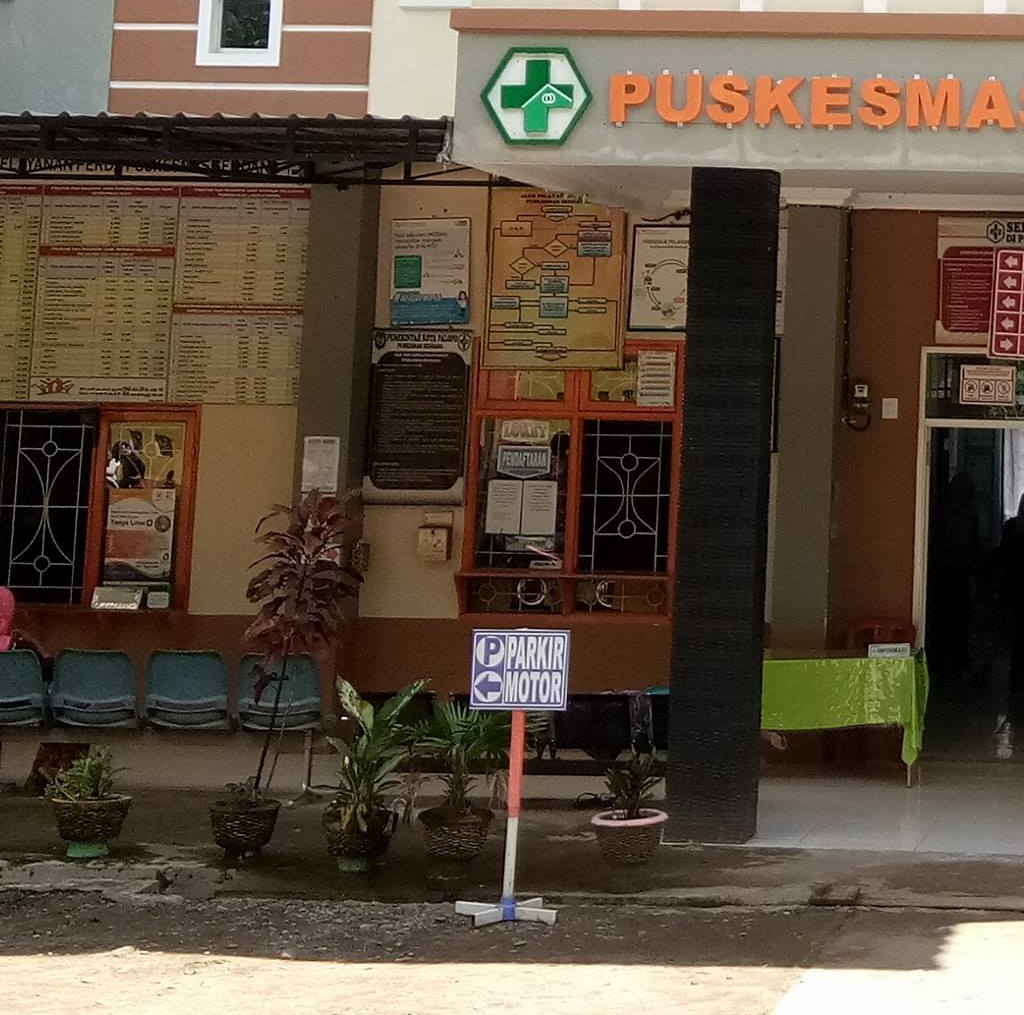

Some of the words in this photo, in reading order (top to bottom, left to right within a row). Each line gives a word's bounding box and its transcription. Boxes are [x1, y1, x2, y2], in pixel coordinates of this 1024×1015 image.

[1005, 235, 1016, 243] DI
[483, 637, 501, 665] P
[506, 636, 564, 670] PARKIR
[504, 670, 562, 703] MOTOR
